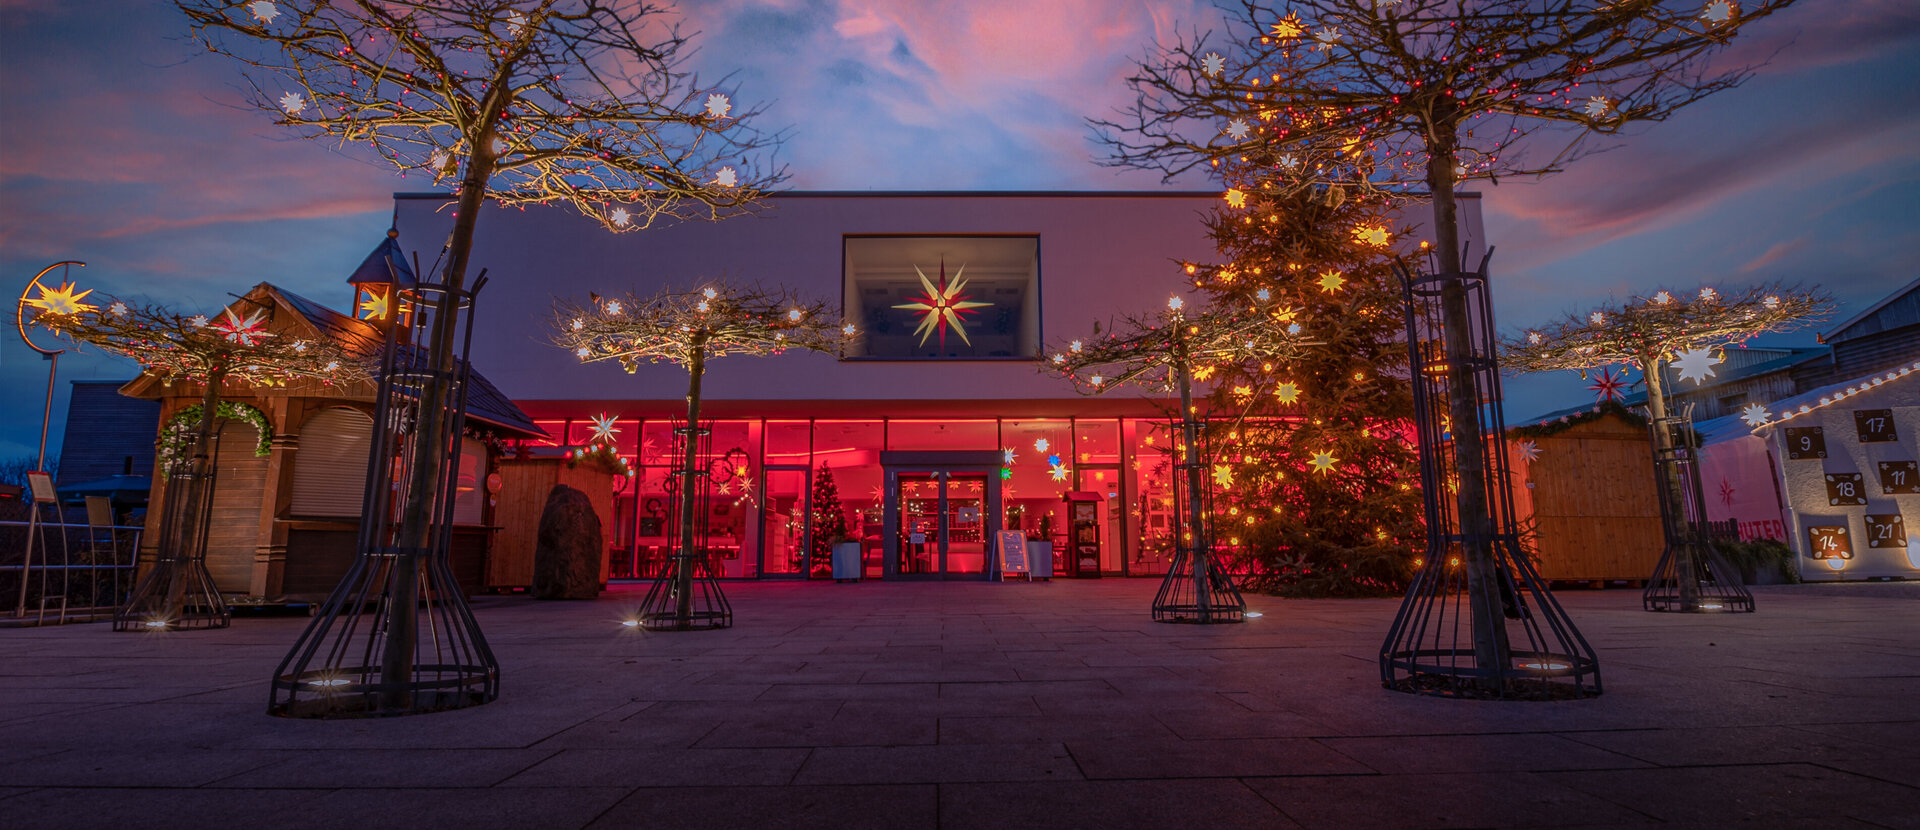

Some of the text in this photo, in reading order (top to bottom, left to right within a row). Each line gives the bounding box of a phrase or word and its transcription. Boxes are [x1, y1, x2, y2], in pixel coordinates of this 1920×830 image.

[1865, 417, 1885, 432] 17
[1800, 436, 1811, 450] 9
[1891, 470, 1905, 485] 11
[1836, 482, 1855, 497] 18
[1875, 523, 1893, 539] 21
[1819, 535, 1837, 550] 14
